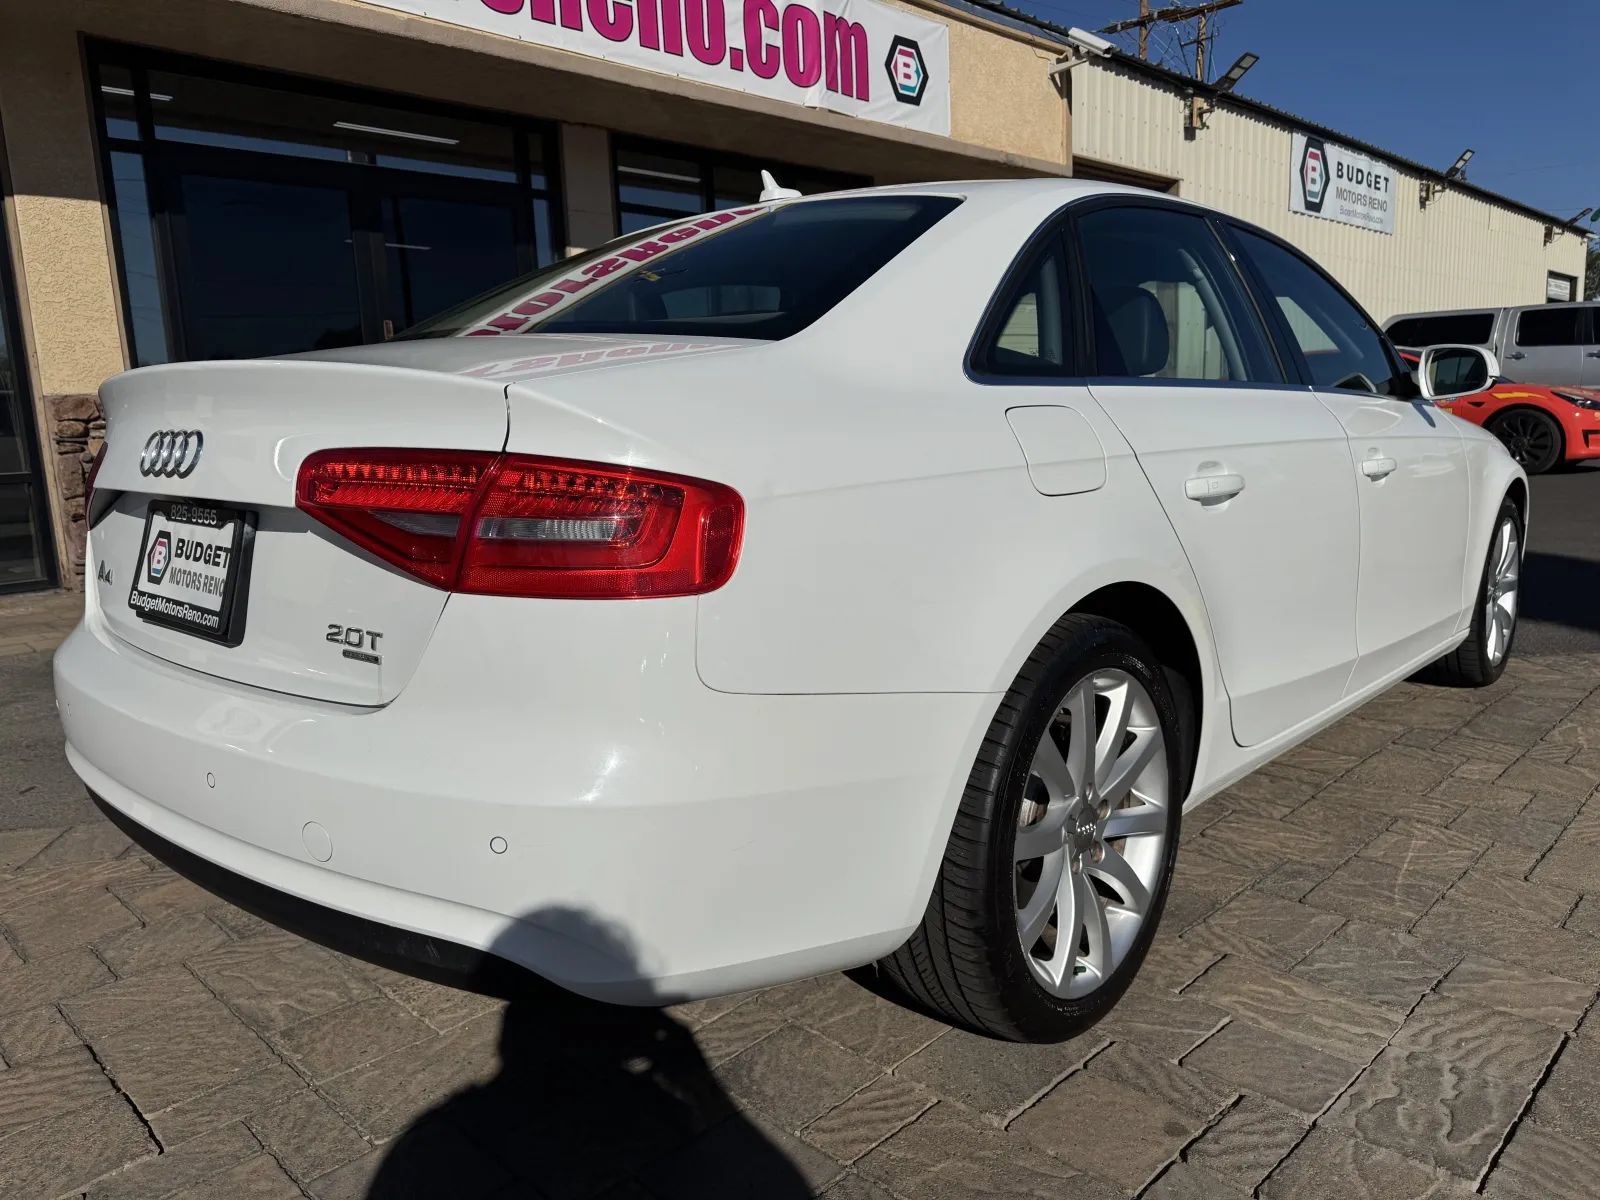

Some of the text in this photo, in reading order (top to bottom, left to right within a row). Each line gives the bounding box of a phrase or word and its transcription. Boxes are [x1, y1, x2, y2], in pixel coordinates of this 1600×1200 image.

[1336, 161, 1390, 193] BUDGET
[1336, 187, 1388, 212] MOTORS RENO
[170, 504, 217, 525] 825-9555
[174, 537, 232, 568] BUDGET
[97, 559, 113, 586] A4
[169, 566, 202, 591] MOTORS
[130, 590, 219, 628] BudgetMotorsReno.com
